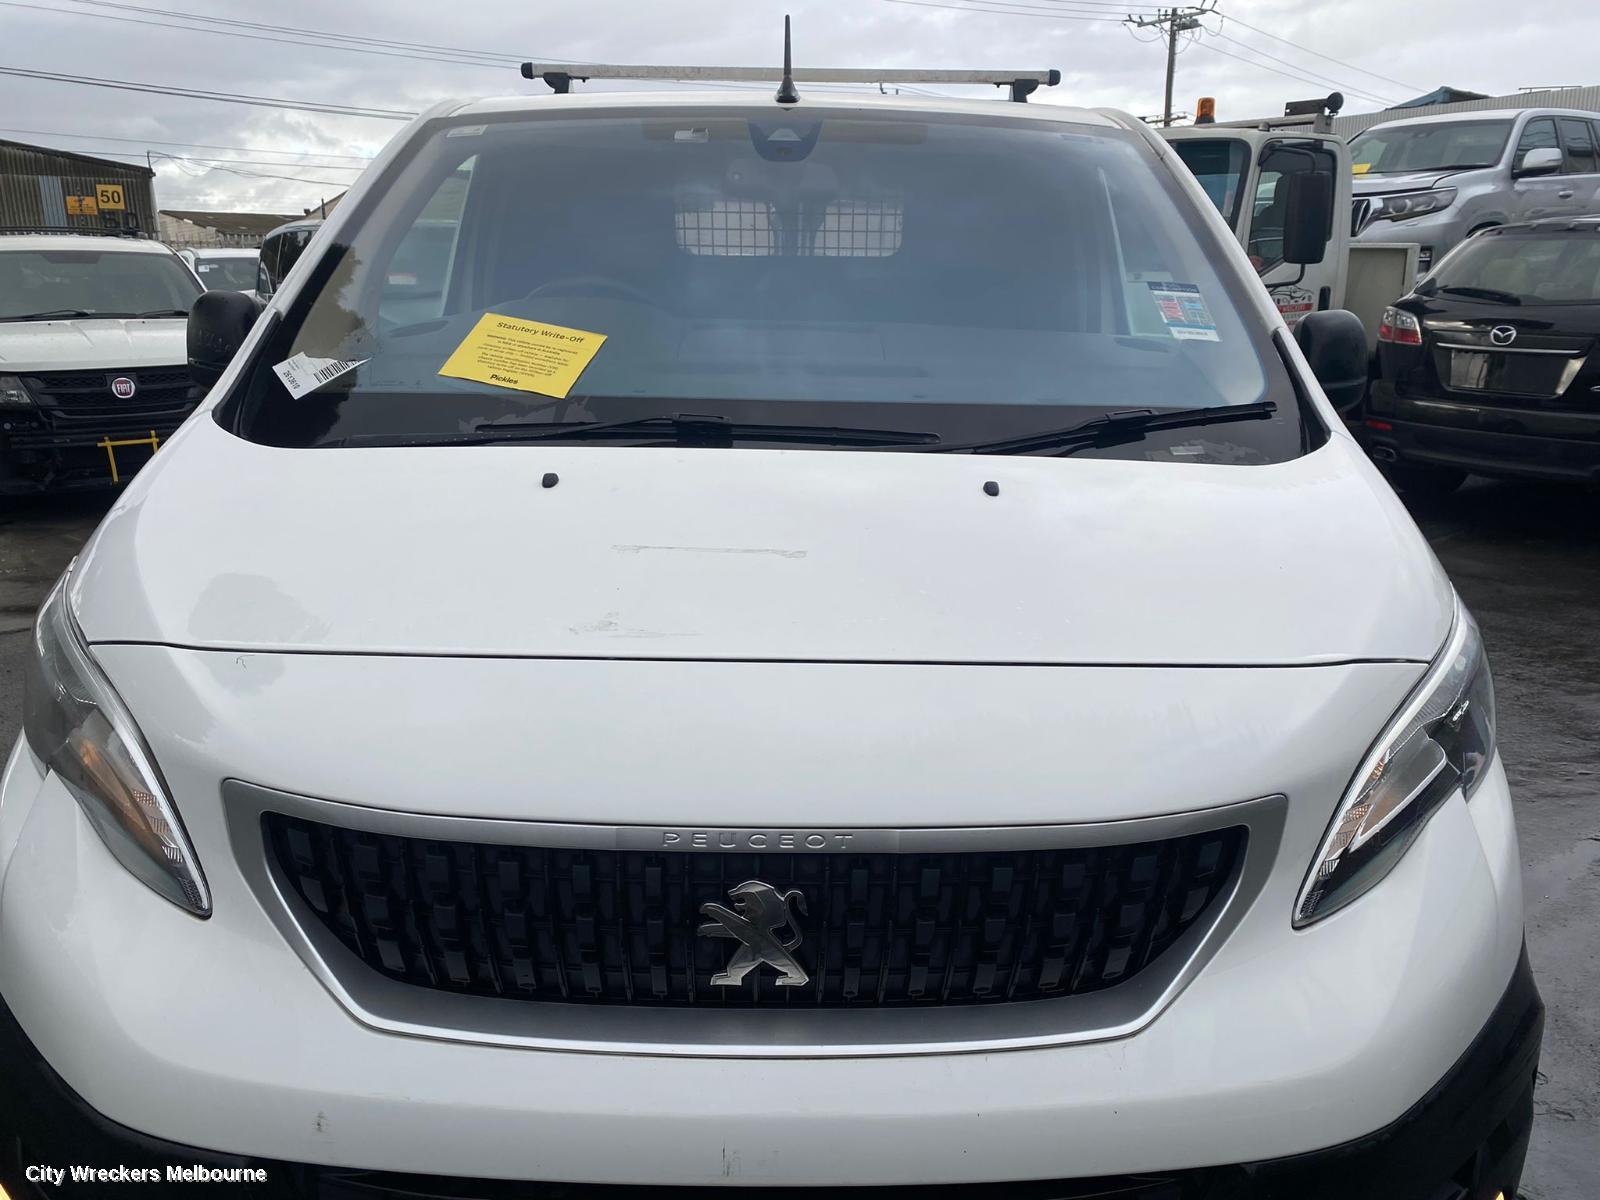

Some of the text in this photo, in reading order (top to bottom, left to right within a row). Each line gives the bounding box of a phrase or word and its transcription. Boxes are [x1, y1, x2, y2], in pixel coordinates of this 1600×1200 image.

[100, 190, 121, 204] 50
[496, 321, 539, 336] Statutory
[541, 329, 584, 344] Write-Off
[490, 373, 519, 385] Pickles
[116, 383, 131, 393] FIAT
[663, 832, 853, 849] PEUGEOT
